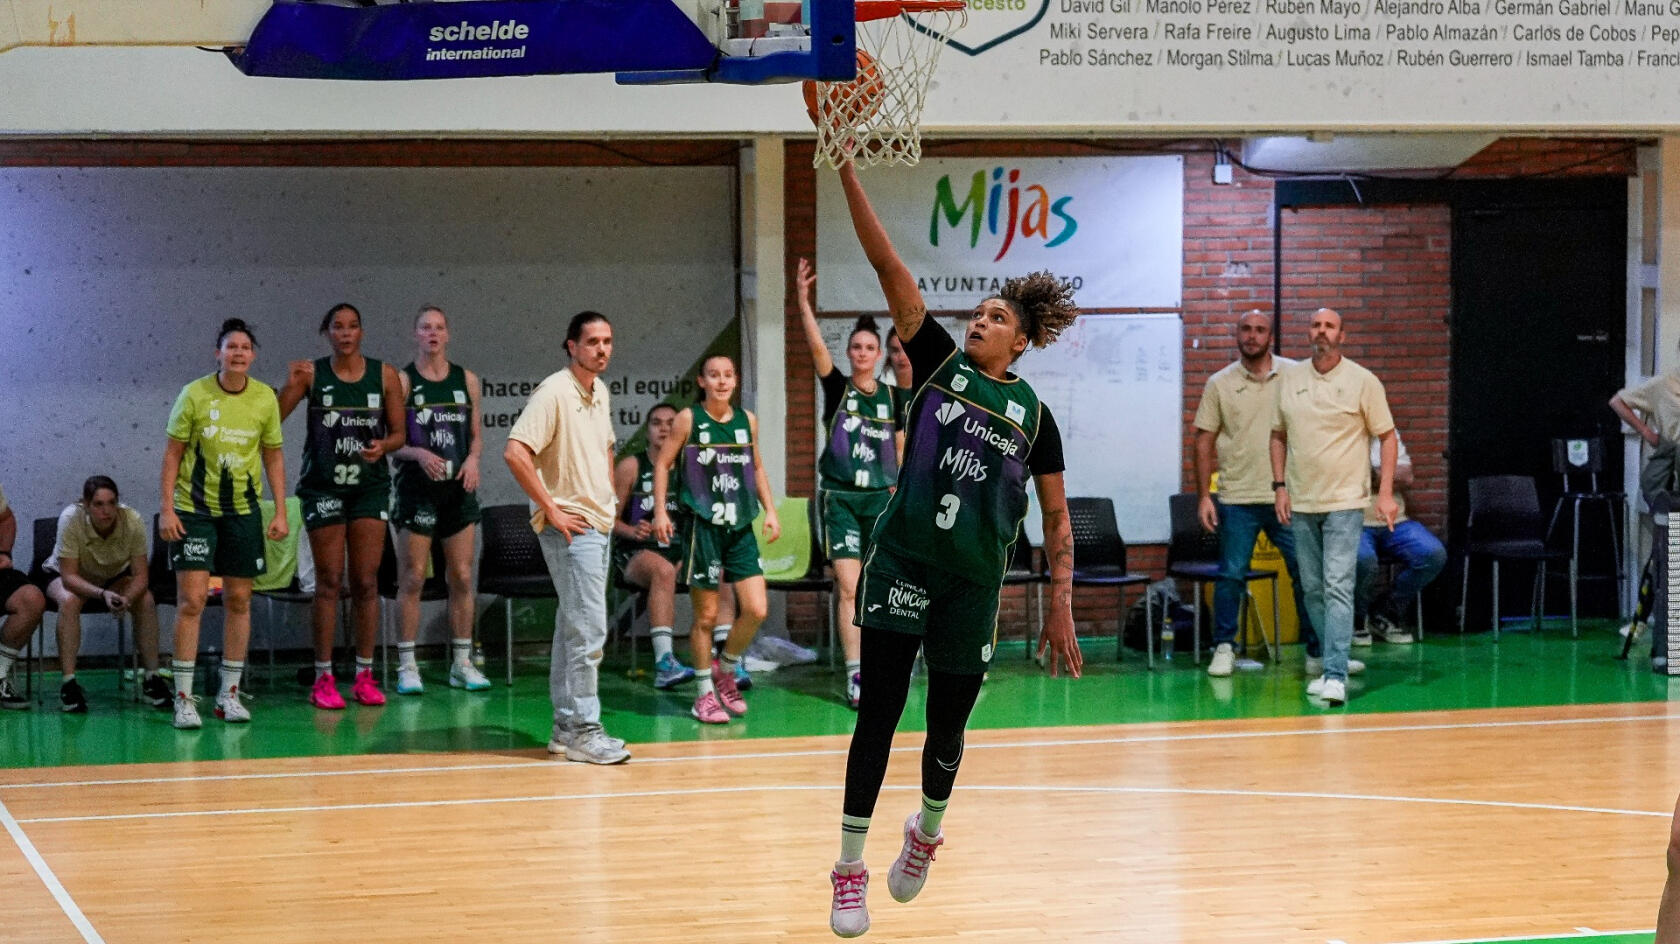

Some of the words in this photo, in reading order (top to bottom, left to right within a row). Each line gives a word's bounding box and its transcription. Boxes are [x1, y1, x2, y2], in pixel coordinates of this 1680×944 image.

[1061, 0, 1104, 13] David
[1110, 0, 1130, 13] Gil
[1146, 0, 1202, 13] Manolo
[1320, 0, 1361, 18] Mayo
[1374, 0, 1444, 18] Alejandro
[1447, 0, 1480, 15] Alba
[1559, 0, 1611, 16] Gabriel
[1625, 0, 1664, 16] Manu
[428, 20, 529, 41] schelde
[1050, 23, 1081, 39] Miki
[1087, 23, 1149, 40] Servera
[1164, 23, 1200, 39] Rafa
[1207, 23, 1251, 40] Freire
[1266, 24, 1329, 44] Augusto
[1334, 24, 1371, 40] Lima
[1386, 24, 1429, 41] Pablo
[1433, 23, 1498, 41] Almazán
[1513, 24, 1561, 41] Carlos
[1566, 25, 1585, 41] de
[1589, 24, 1637, 41] Cobos
[426, 45, 526, 61] international
[1039, 49, 1083, 66] Pablo
[1087, 49, 1153, 66] Sánchez
[1167, 50, 1223, 71] Morgan
[1227, 50, 1273, 67] Stilma
[1287, 50, 1330, 67] Lucas
[1335, 49, 1384, 67] Muñoz
[1397, 49, 1444, 67] Rubén
[1449, 49, 1513, 67] Guerrero
[1526, 50, 1573, 67] Ismael
[1577, 49, 1624, 67] Tamba
[929, 166, 1078, 262] Mijas
[917, 275, 1083, 293] AYUNTATO
[610, 376, 628, 395] el
[635, 375, 693, 399] equip
[619, 404, 640, 425] tú
[963, 417, 1018, 456] Unicaja
[333, 464, 360, 485] 32
[939, 446, 989, 482] Mijas
[712, 473, 740, 494] Mijas
[854, 469, 870, 488] 11
[711, 501, 737, 526] 24
[935, 493, 961, 530] 3
[889, 606, 920, 620] DENTAL
